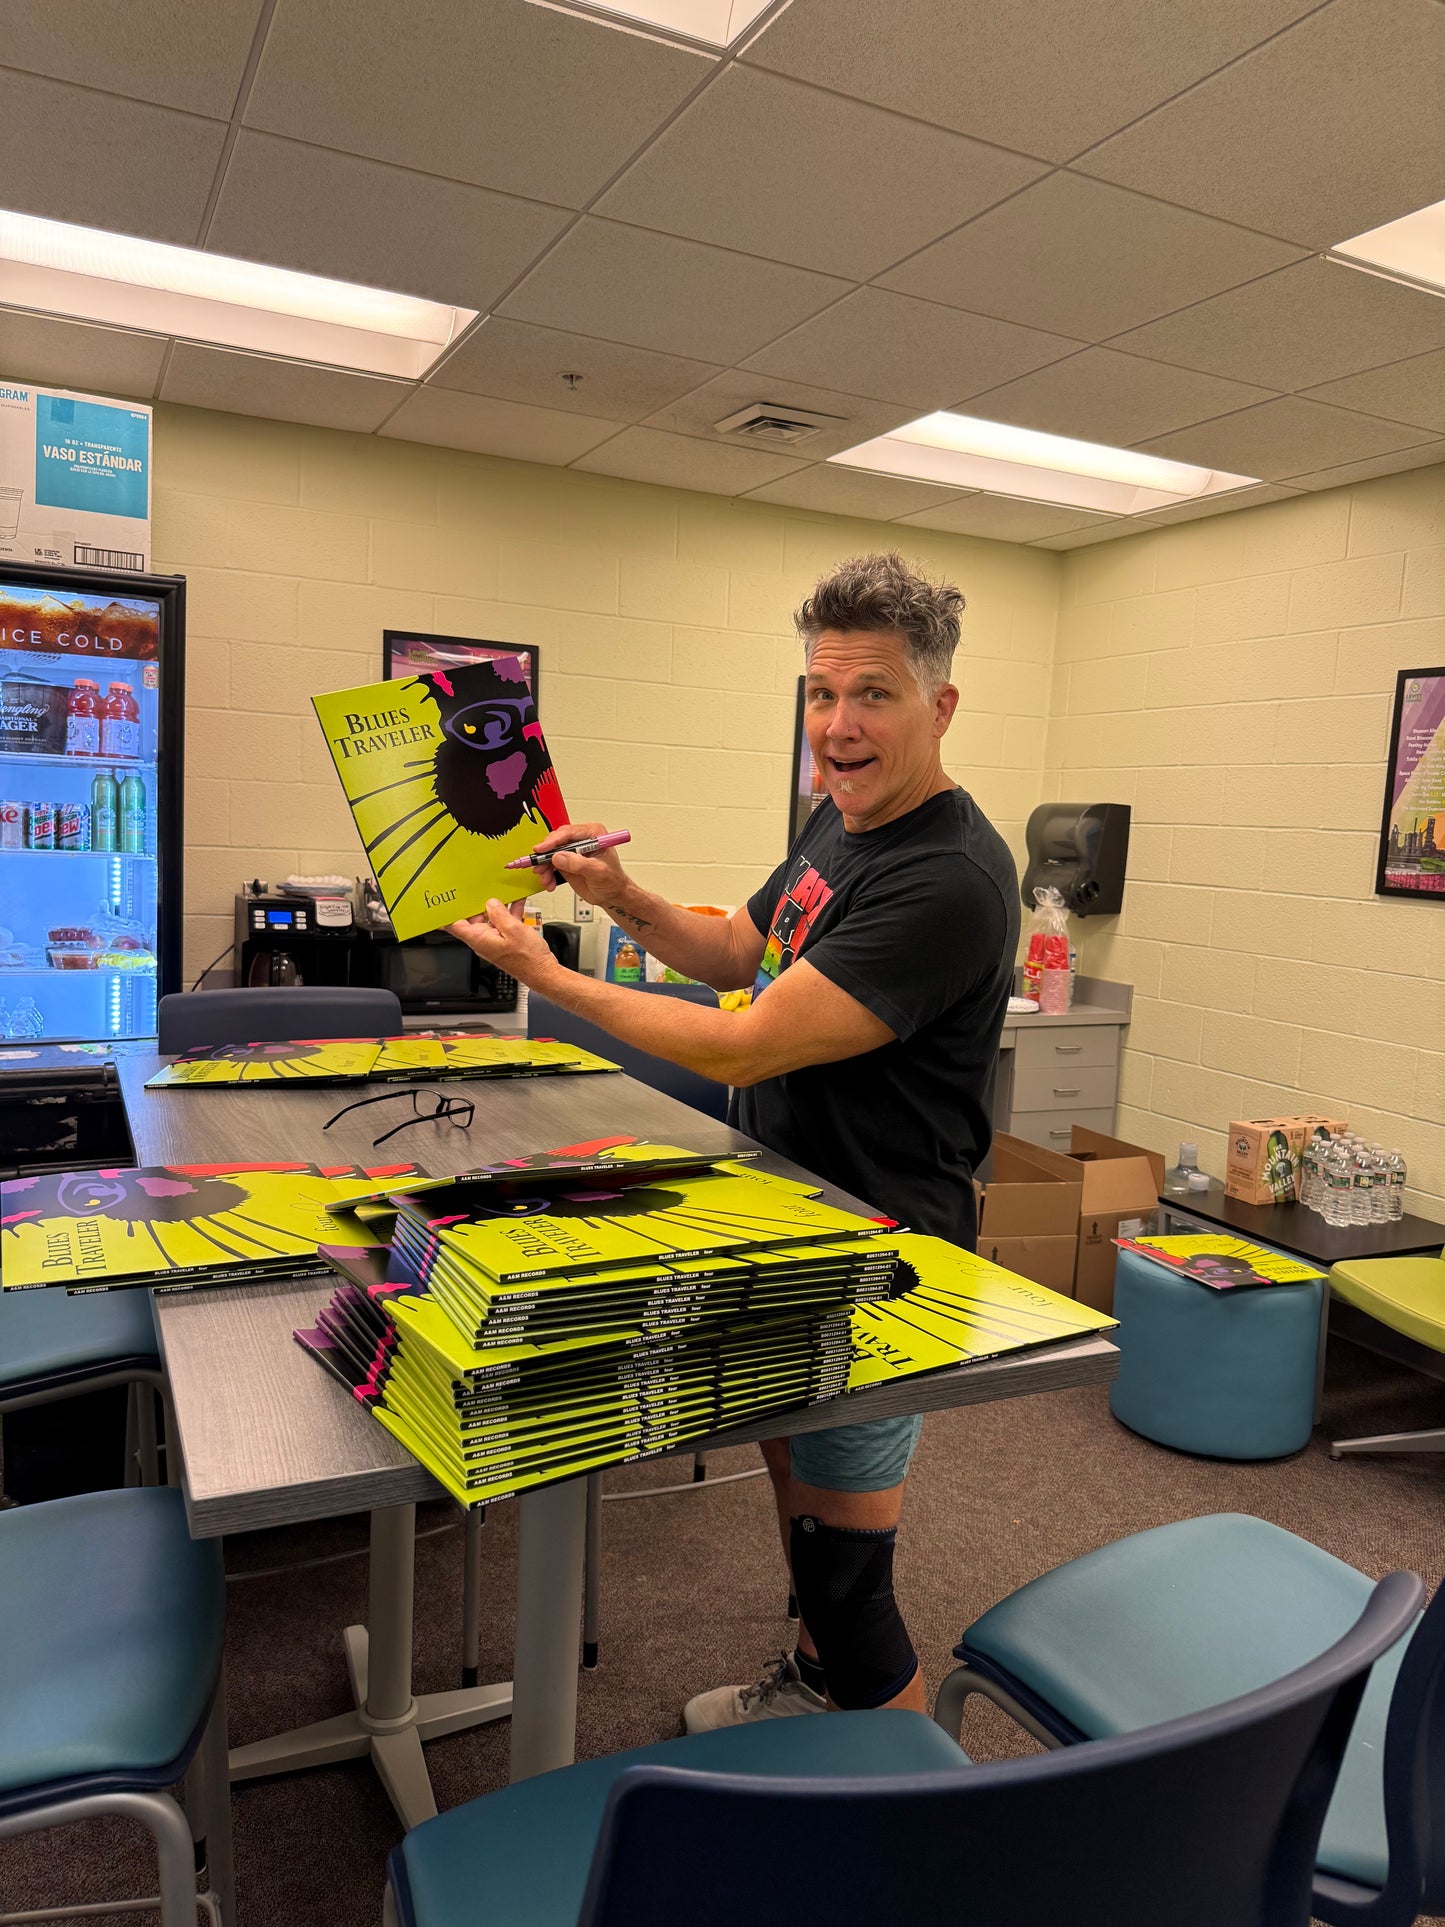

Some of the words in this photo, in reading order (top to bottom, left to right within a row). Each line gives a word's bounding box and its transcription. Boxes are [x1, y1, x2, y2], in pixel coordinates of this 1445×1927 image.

[84, 441, 122, 453] TRANSPARENTE
[42, 444, 76, 462] VASO
[79, 451, 142, 473] ESTÁNDAR
[2, 628, 42, 645] ICE
[57, 632, 124, 651] COLD
[0, 703, 50, 718] engling
[344, 707, 410, 736] BLUES
[333, 724, 436, 758] TRAVELER
[424, 888, 458, 909] four
[1262, 1149, 1300, 1181] MOUNTAIN
[1269, 1174, 1295, 1193] VALLEY
[314, 1216, 340, 1232] four
[500, 1228, 560, 1258] BLUES
[523, 1218, 602, 1261] TRAVELER
[42, 1232, 73, 1269] BLUES
[75, 1220, 107, 1275] TRAVELER
[507, 1272, 520, 1280] A&M
[521, 1270, 546, 1278] RECORDS
[498, 1293, 512, 1301] A&M
[1007, 1285, 1056, 1307] four
[495, 1306, 508, 1314] A&M
[510, 1304, 536, 1312] RECORDS
[488, 1317, 501, 1325] A&M
[503, 1315, 529, 1323] RECORDS
[484, 1328, 497, 1336] A&M
[498, 1326, 524, 1334] RECORDS
[486, 1364, 512, 1373] RECORDS
[635, 1360, 659, 1368] TRAVELER
[635, 1370, 659, 1378] TRAVELER
[482, 1382, 495, 1390] A&M
[496, 1378, 521, 1387] RECORDS
[640, 1378, 665, 1386] TRAVELER
[639, 1388, 664, 1397] TRAVELER
[476, 1396, 502, 1404] RECORDS
[484, 1405, 509, 1413] RECORDS
[640, 1401, 664, 1410] TRAVELER
[482, 1417, 508, 1426] RECORDS
[641, 1412, 666, 1421] TRAVELER
[642, 1424, 666, 1434] TRAVELER
[484, 1433, 509, 1442] RECORDS
[640, 1434, 664, 1444] TRAVELER
[486, 1446, 512, 1455] RECORDS
[640, 1448, 662, 1458] TRAVELER
[489, 1461, 514, 1470] RECORDS
[487, 1472, 513, 1482] RECORDS
[477, 1499, 490, 1507] A&M
[491, 1492, 515, 1503] RECORDS
